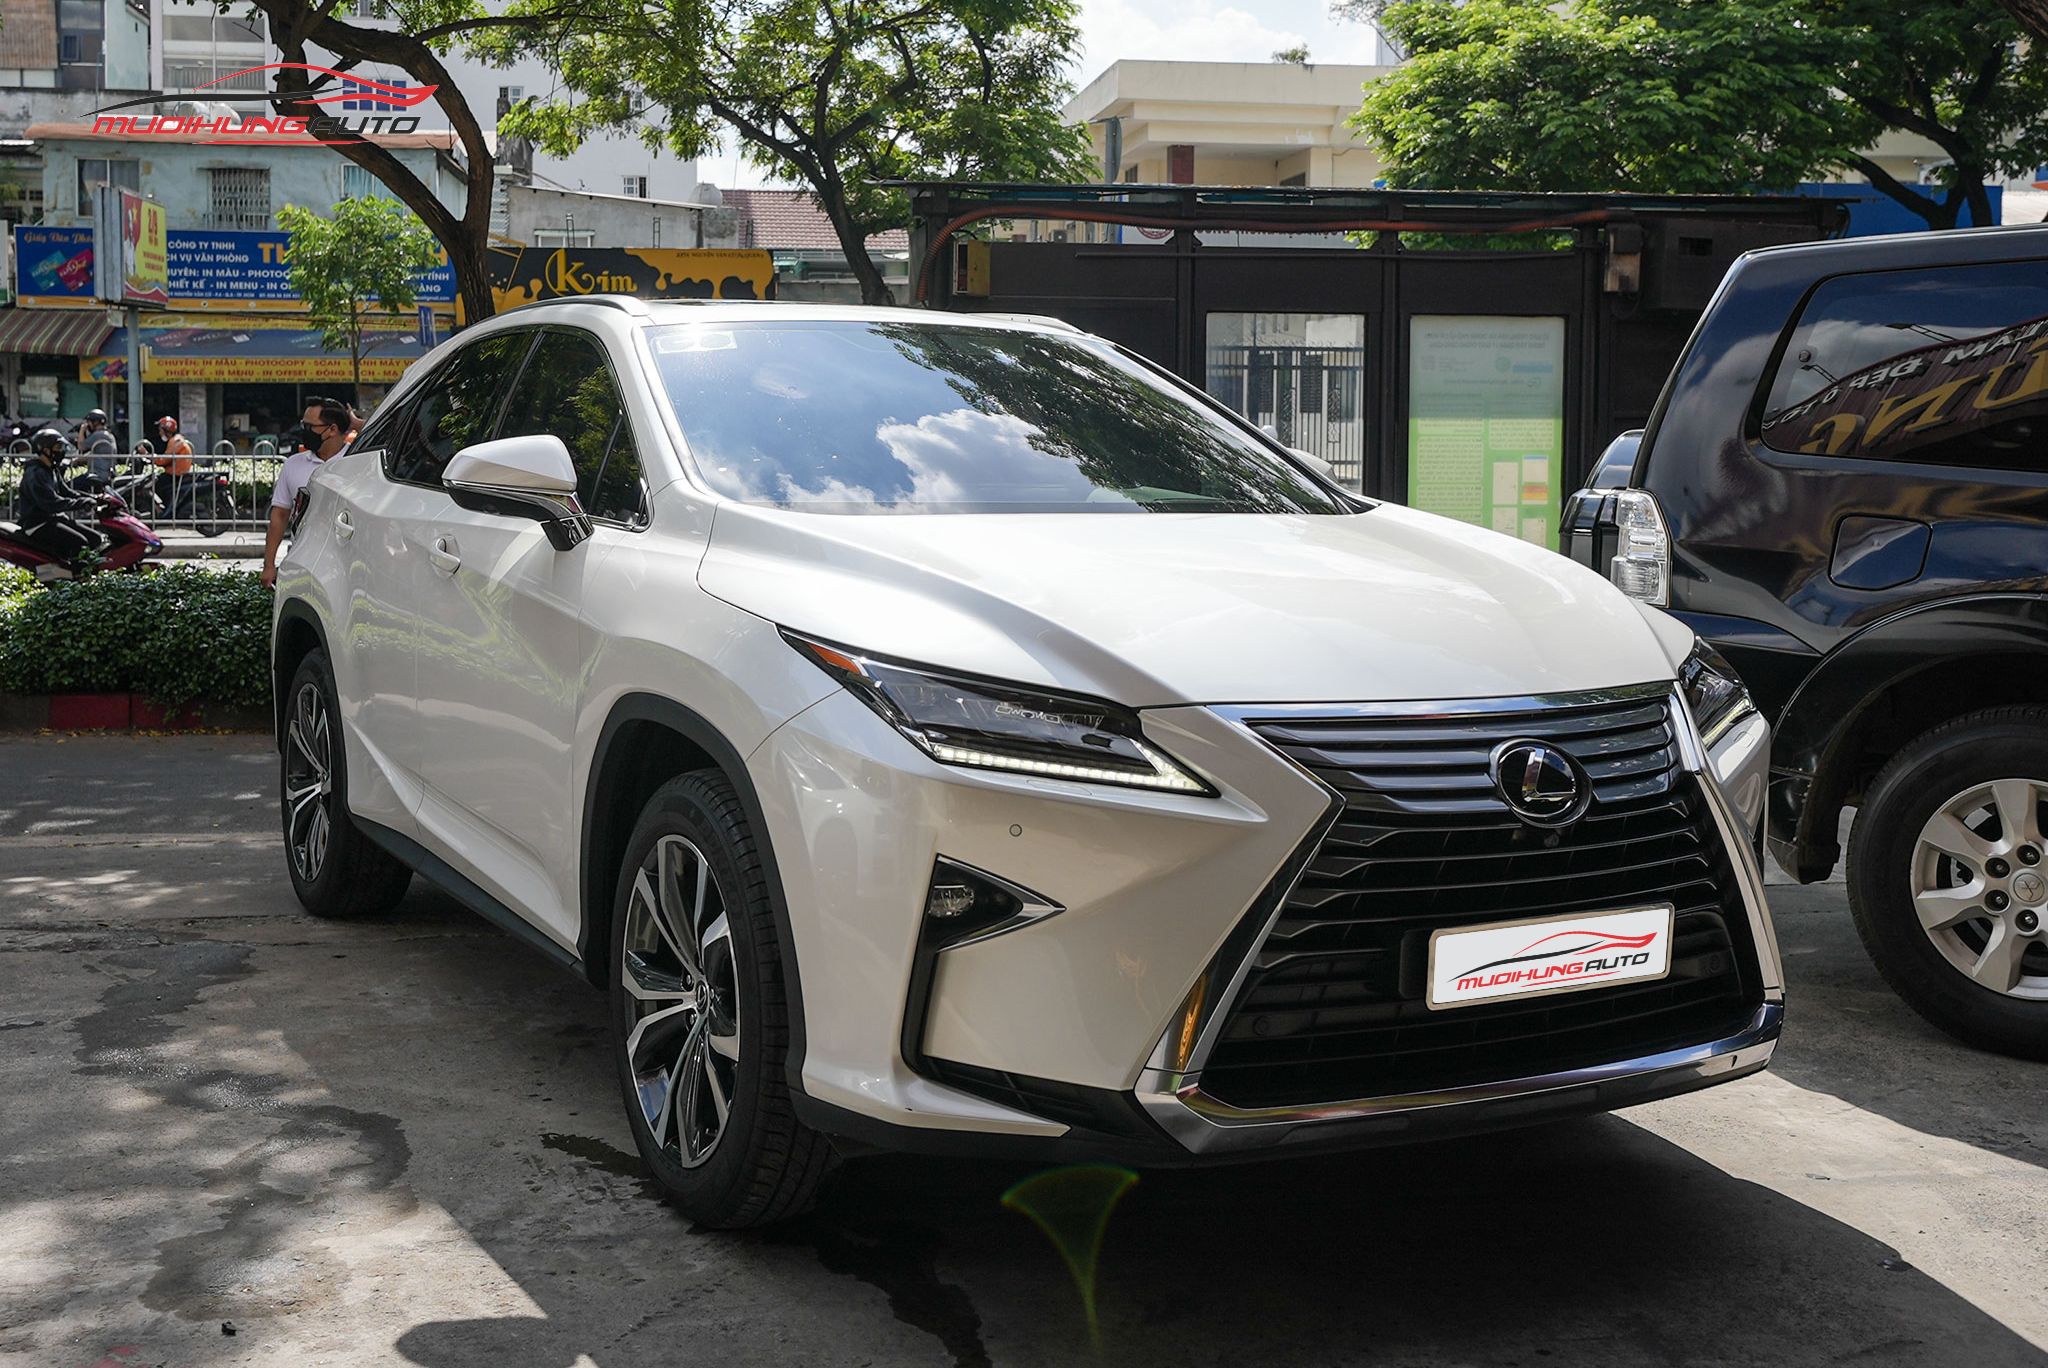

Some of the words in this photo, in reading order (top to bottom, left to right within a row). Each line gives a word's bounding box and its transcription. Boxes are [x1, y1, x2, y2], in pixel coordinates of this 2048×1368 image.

[167, 239, 197, 250] CÔNG
[199, 241, 209, 250] TY
[211, 242, 236, 250] TNHH
[180, 253, 192, 263] VỤ
[194, 252, 214, 262] VĂN
[216, 253, 250, 263] PHÒNG
[202, 269, 213, 277] IN
[168, 279, 190, 289] HIẾT
[216, 281, 227, 289] IN
[229, 281, 258, 290] MENU
[266, 281, 278, 290] IN
